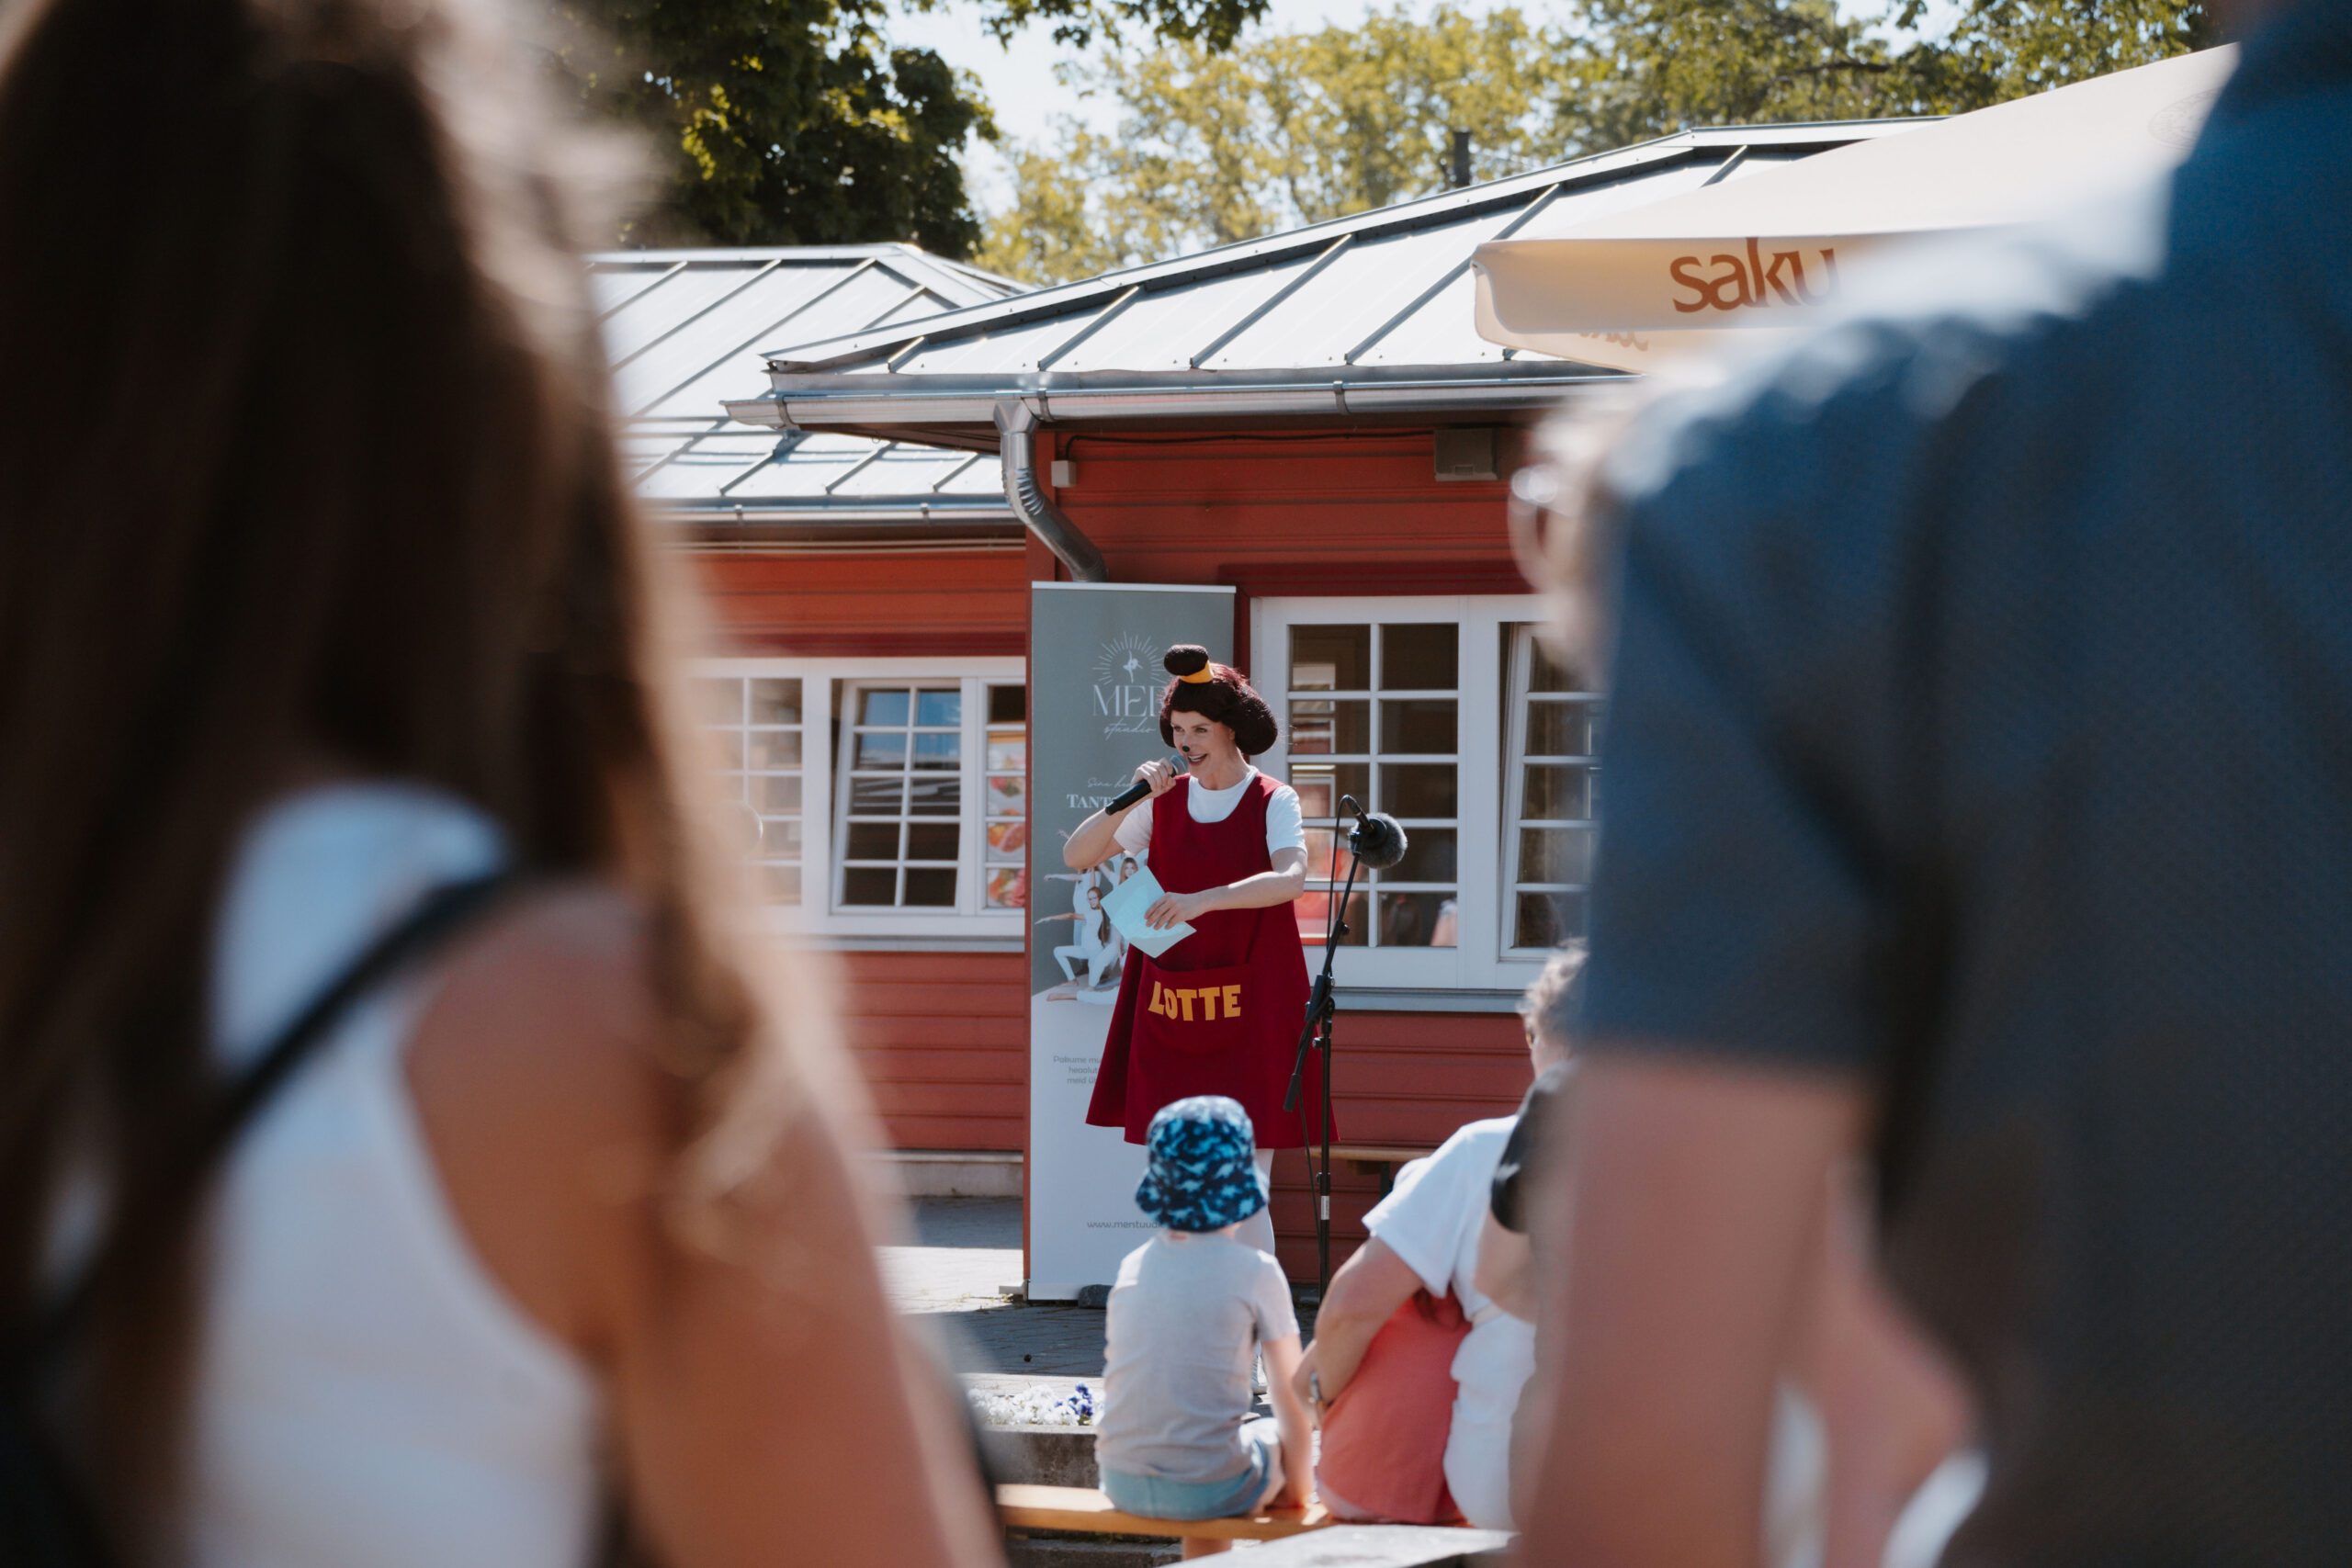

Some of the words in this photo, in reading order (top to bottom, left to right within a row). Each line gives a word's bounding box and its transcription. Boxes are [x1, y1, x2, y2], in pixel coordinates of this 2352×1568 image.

[1669, 236, 1840, 313] saku
[1067, 794, 1114, 808] TANT
[1148, 980, 1241, 1021] LOTTE
